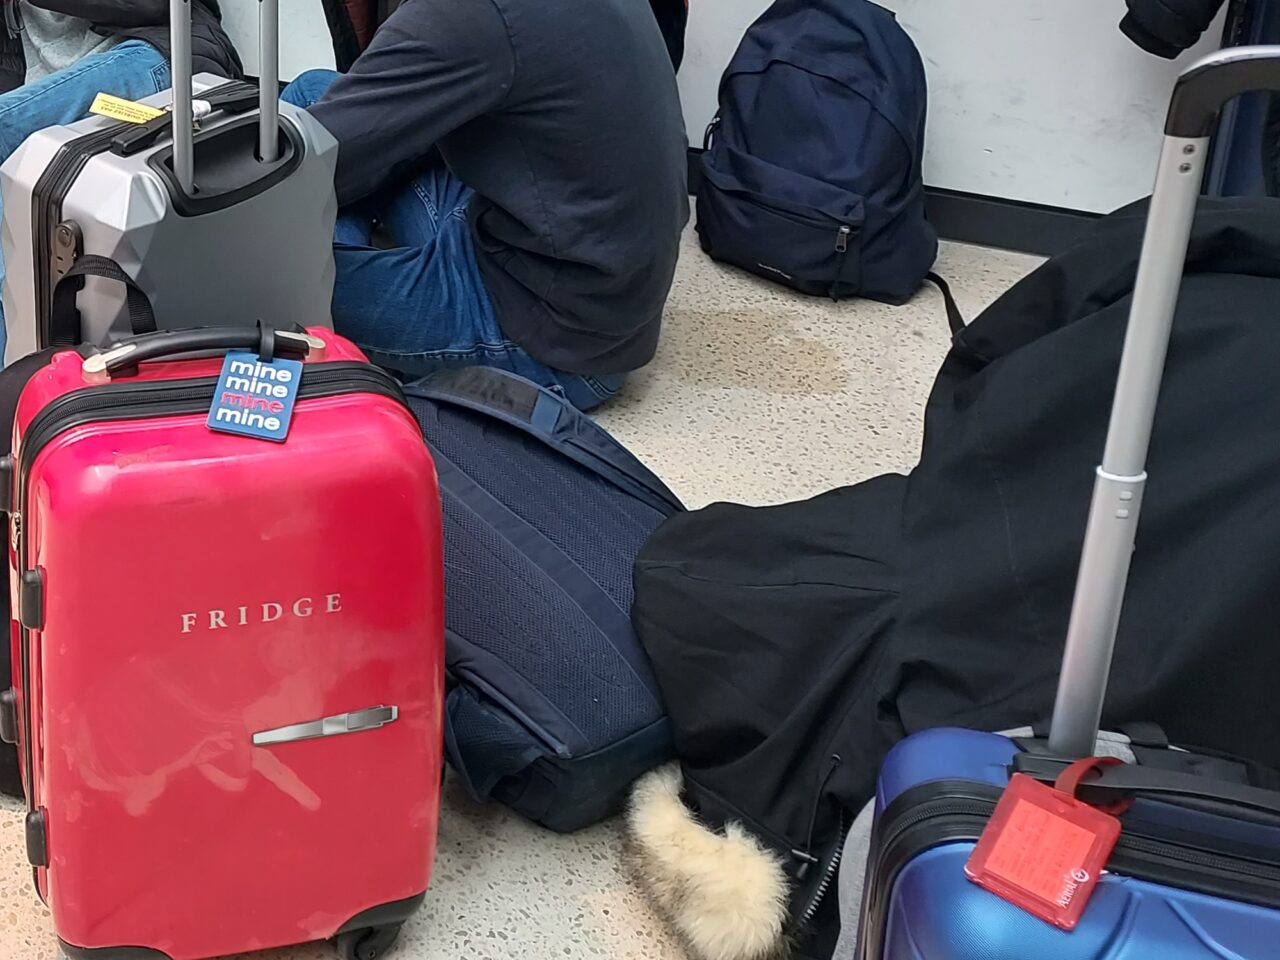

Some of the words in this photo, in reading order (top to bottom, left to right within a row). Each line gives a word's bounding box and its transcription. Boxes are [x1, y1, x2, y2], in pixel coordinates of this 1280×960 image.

[230, 360, 292, 382] mine
[225, 375, 288, 398] mine
[221, 391, 284, 414] mine
[216, 407, 280, 431] mine
[180, 593, 342, 633] FRIDGE
